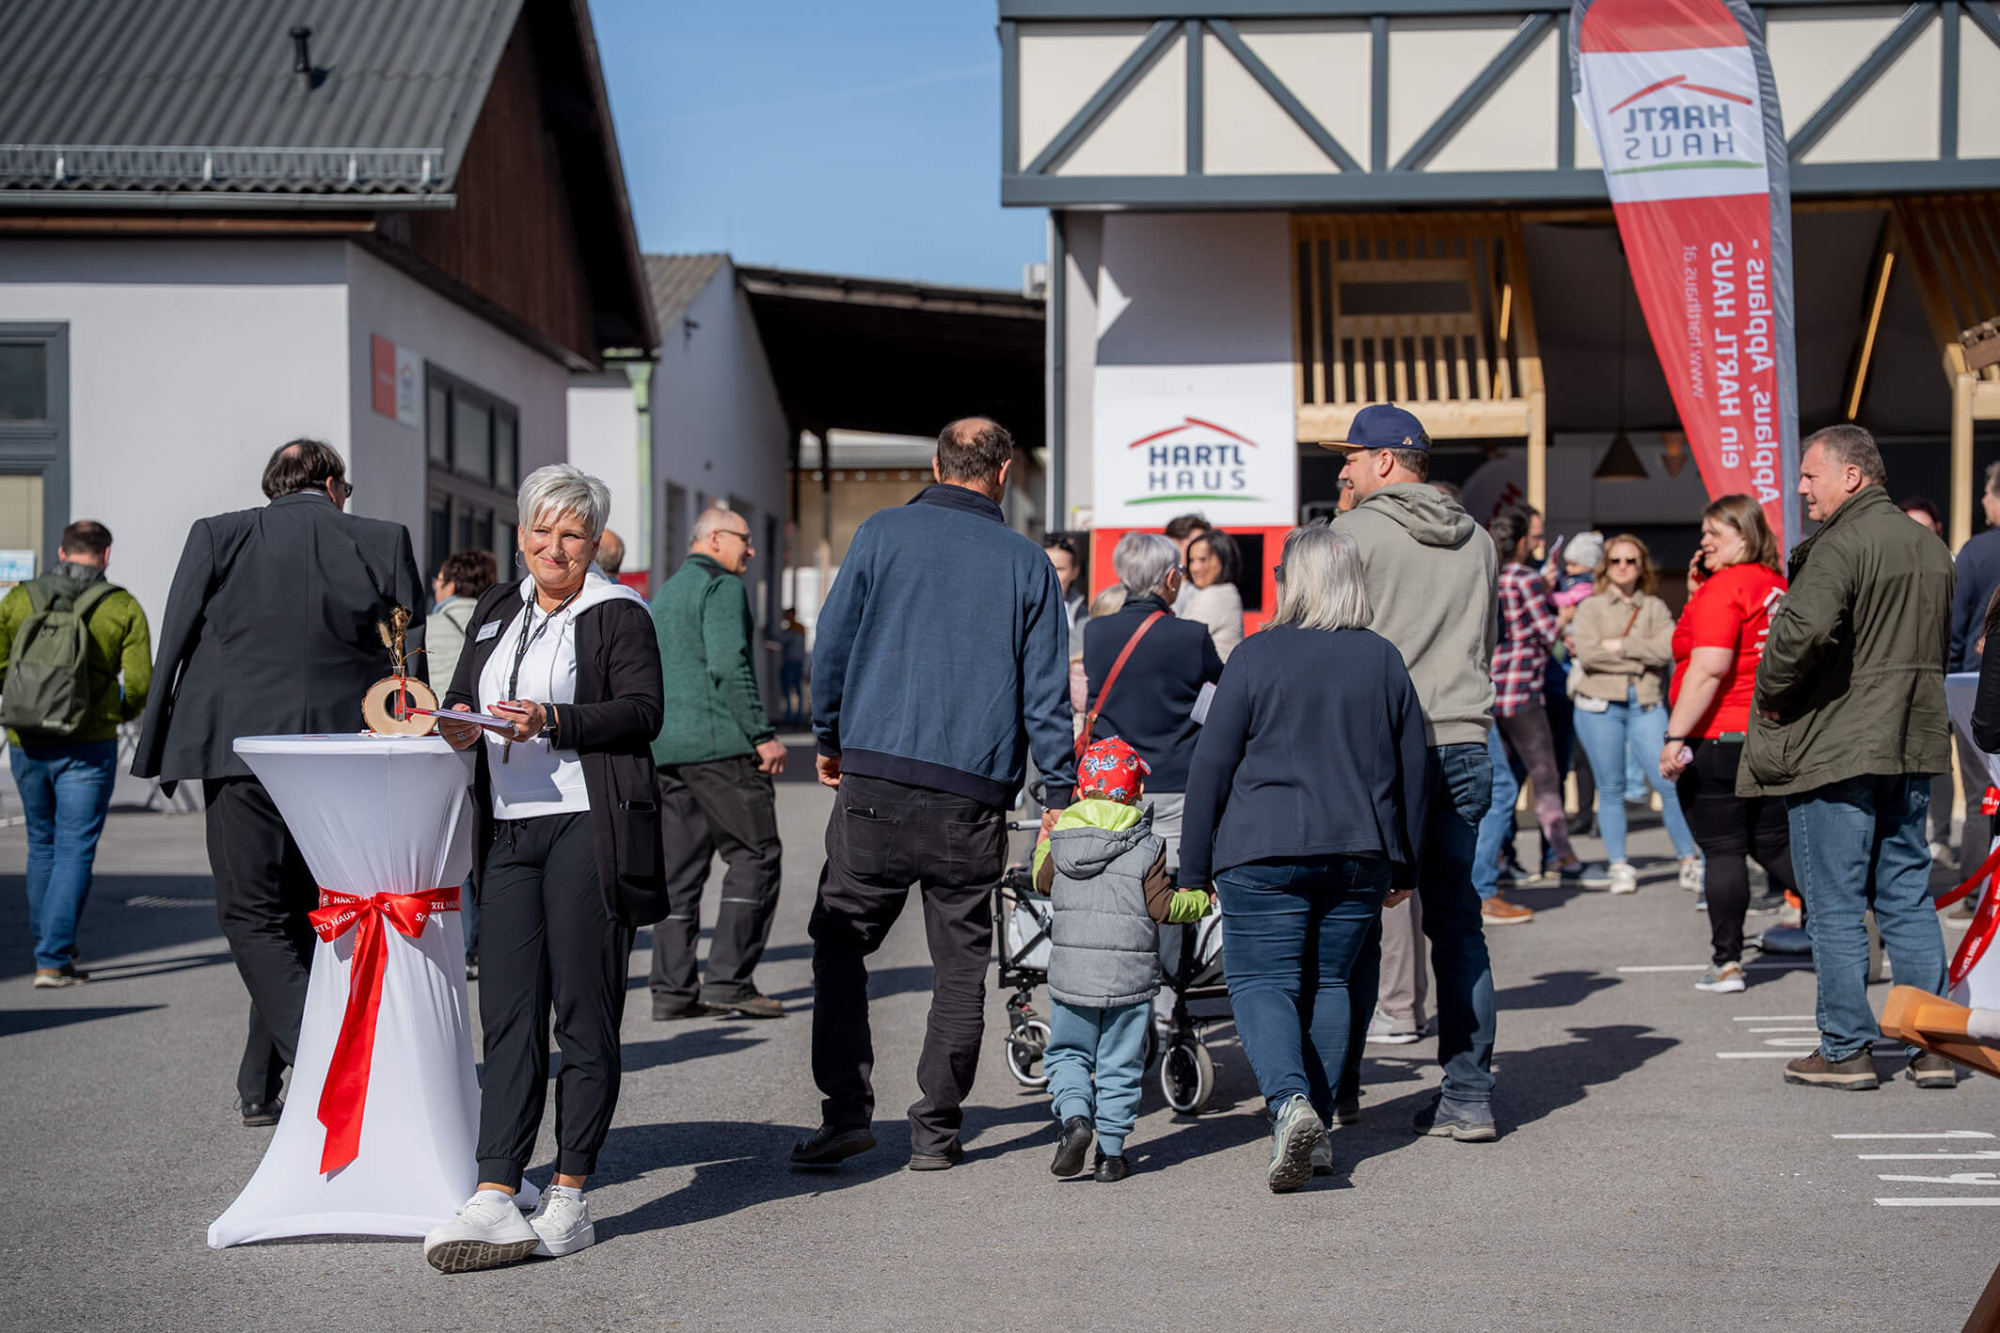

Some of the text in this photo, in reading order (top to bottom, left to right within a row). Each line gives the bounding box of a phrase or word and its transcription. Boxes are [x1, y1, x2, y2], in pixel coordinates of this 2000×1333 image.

[1149, 445, 1245, 467] HARTL
[1149, 469, 1246, 490] HAUS
[313, 911, 356, 933] RTL HAUS
